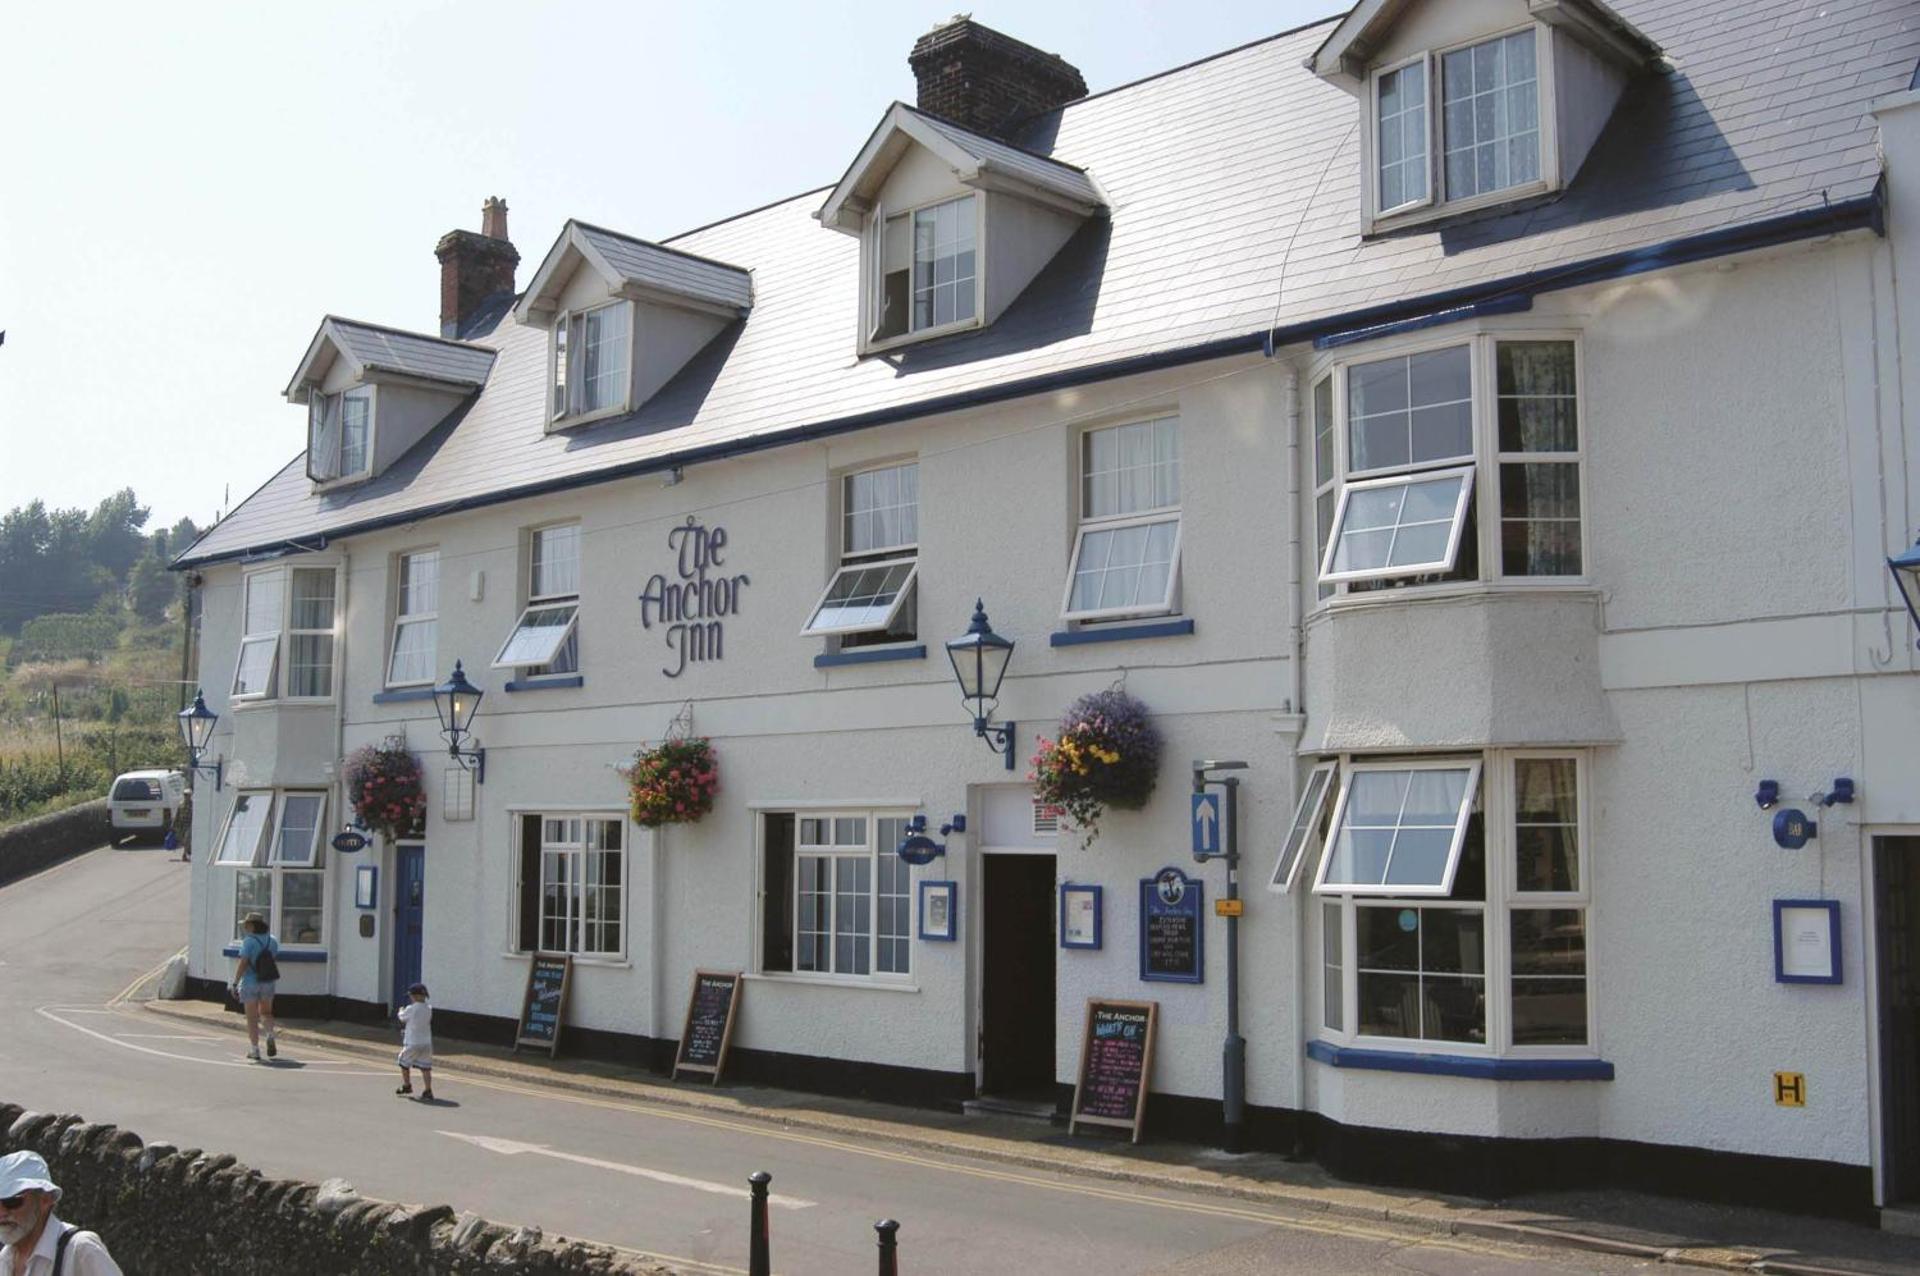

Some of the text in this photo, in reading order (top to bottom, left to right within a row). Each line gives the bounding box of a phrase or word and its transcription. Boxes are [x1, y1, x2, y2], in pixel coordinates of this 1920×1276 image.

[669, 515, 727, 579] The
[638, 563, 751, 629] Anchor
[662, 620, 724, 678] Inn
[1097, 1011, 1146, 1022] THE ANCHOR
[1778, 1075, 1800, 1102] H
